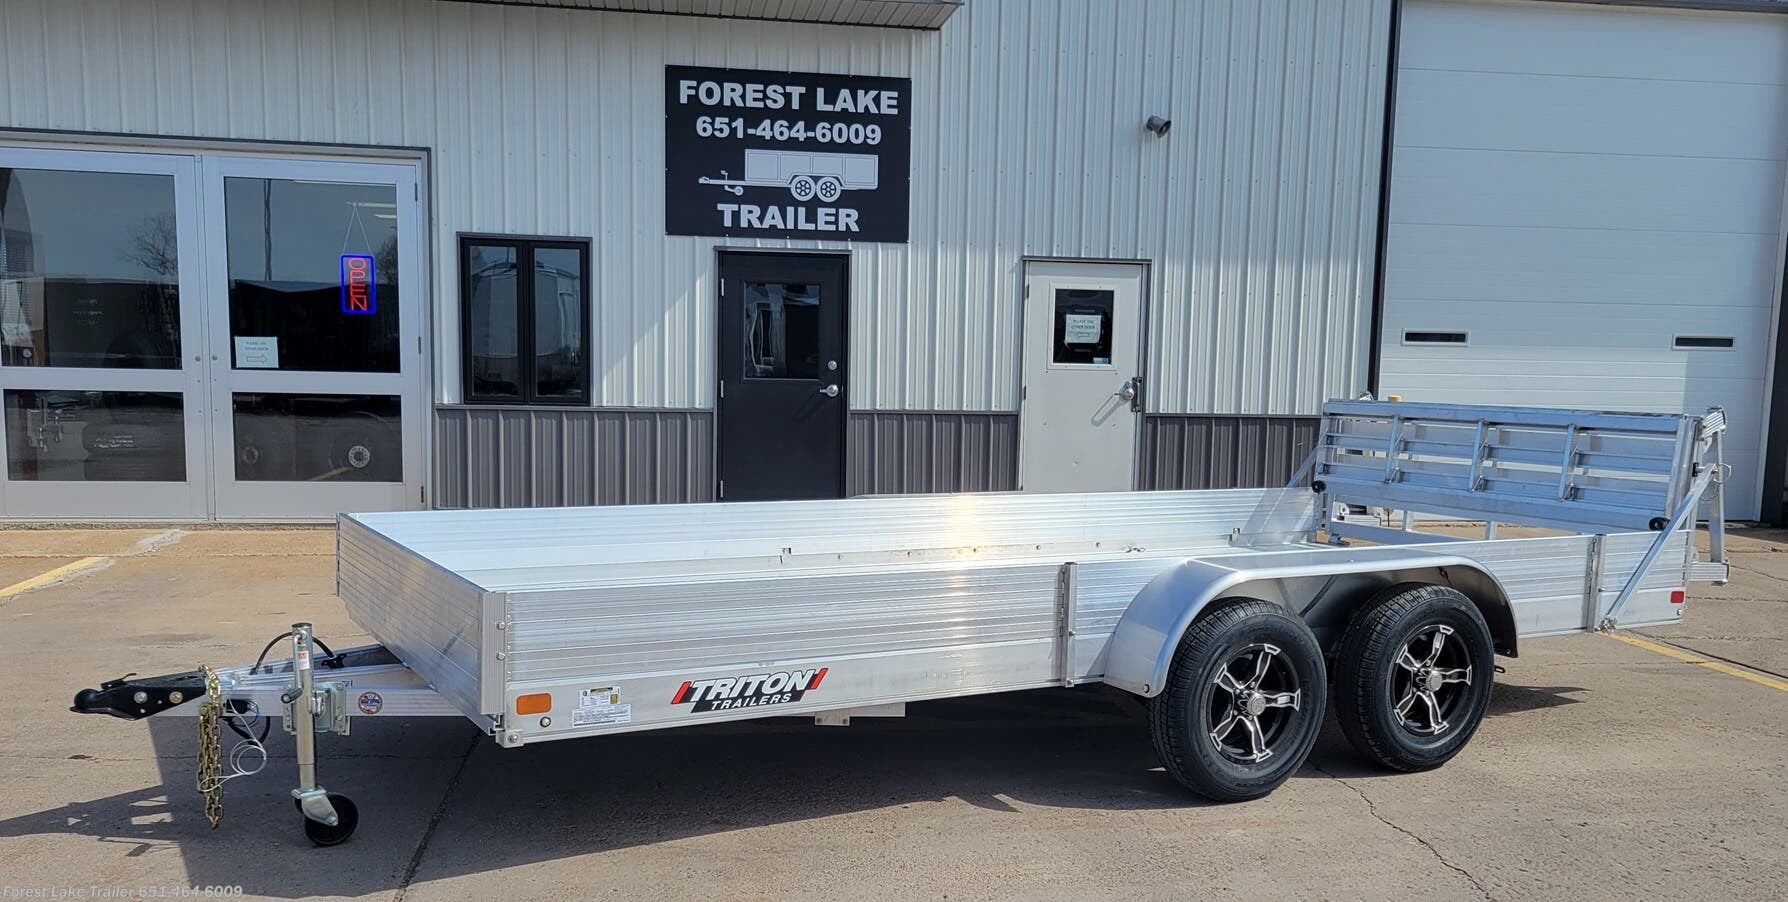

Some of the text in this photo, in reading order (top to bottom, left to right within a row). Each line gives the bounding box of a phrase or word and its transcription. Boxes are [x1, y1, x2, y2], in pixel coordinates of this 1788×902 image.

[679, 79, 899, 115] FOREST LAKE
[696, 116, 882, 145] 651-464-6009
[717, 203, 860, 232] TRAILER
[348, 257, 368, 312] OPEN
[690, 669, 816, 702] TRITON
[711, 693, 792, 711] TRAILERS
